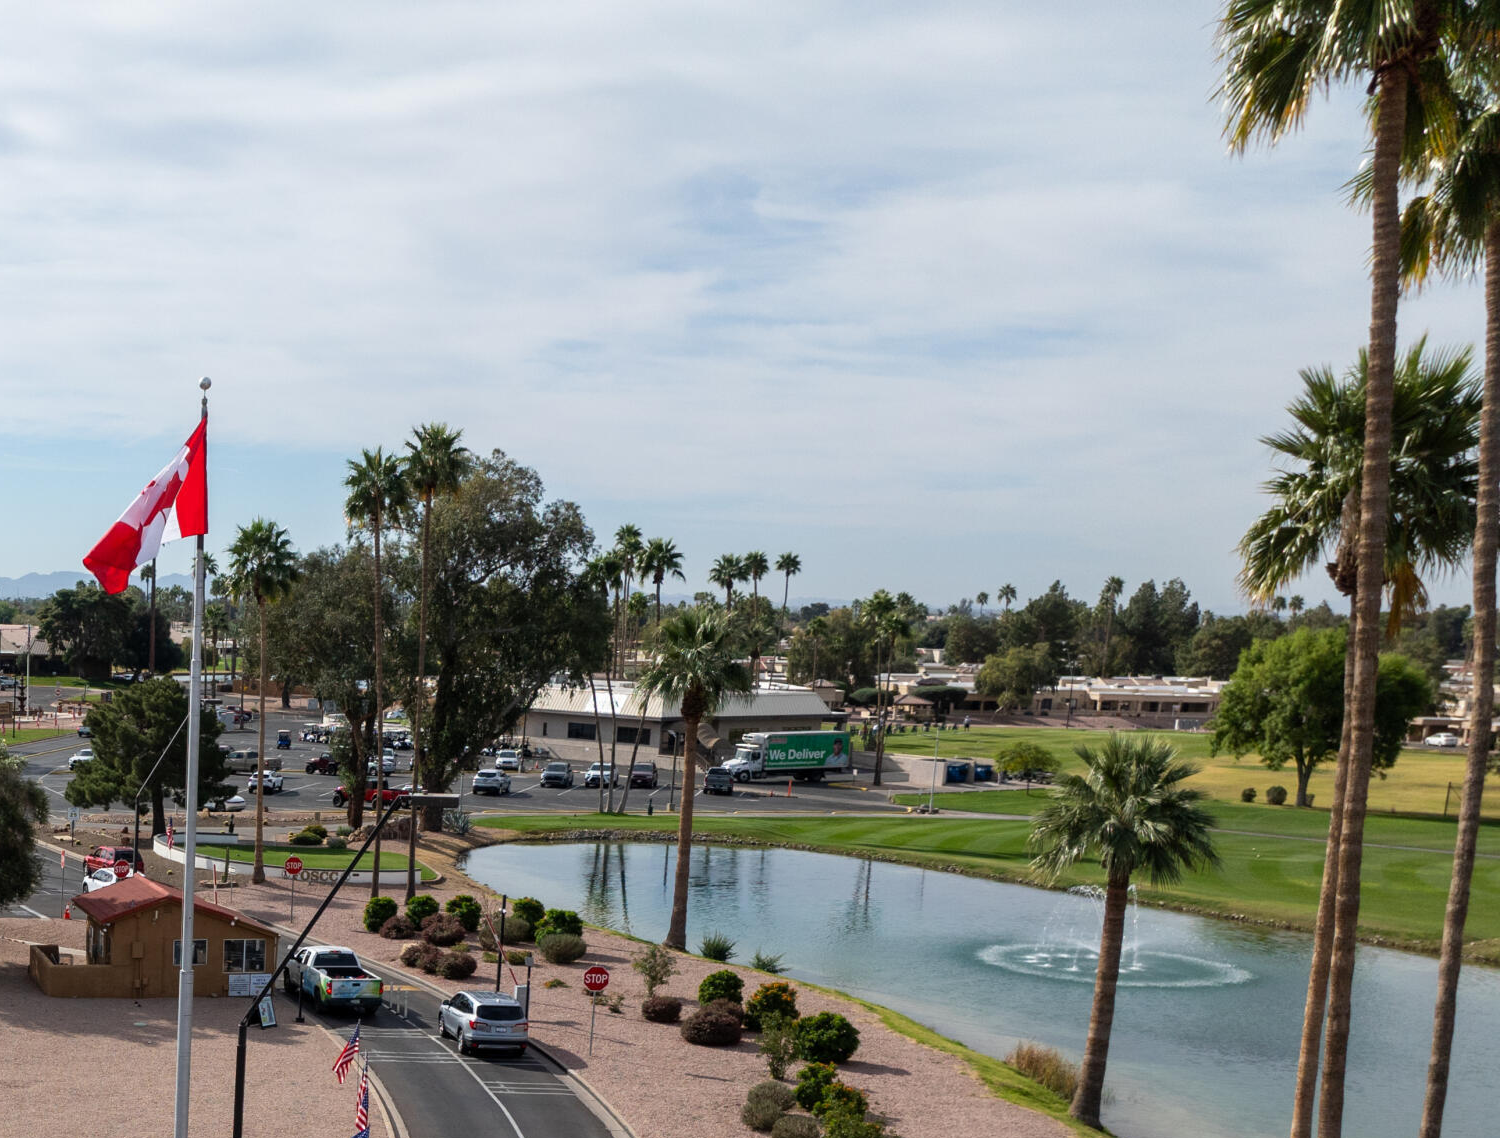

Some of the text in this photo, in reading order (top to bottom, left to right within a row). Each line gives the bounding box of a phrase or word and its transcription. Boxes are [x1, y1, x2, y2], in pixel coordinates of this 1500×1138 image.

[769, 749, 826, 760] We Deliver
[286, 862, 302, 870] STOP
[585, 973, 608, 984] STOP
